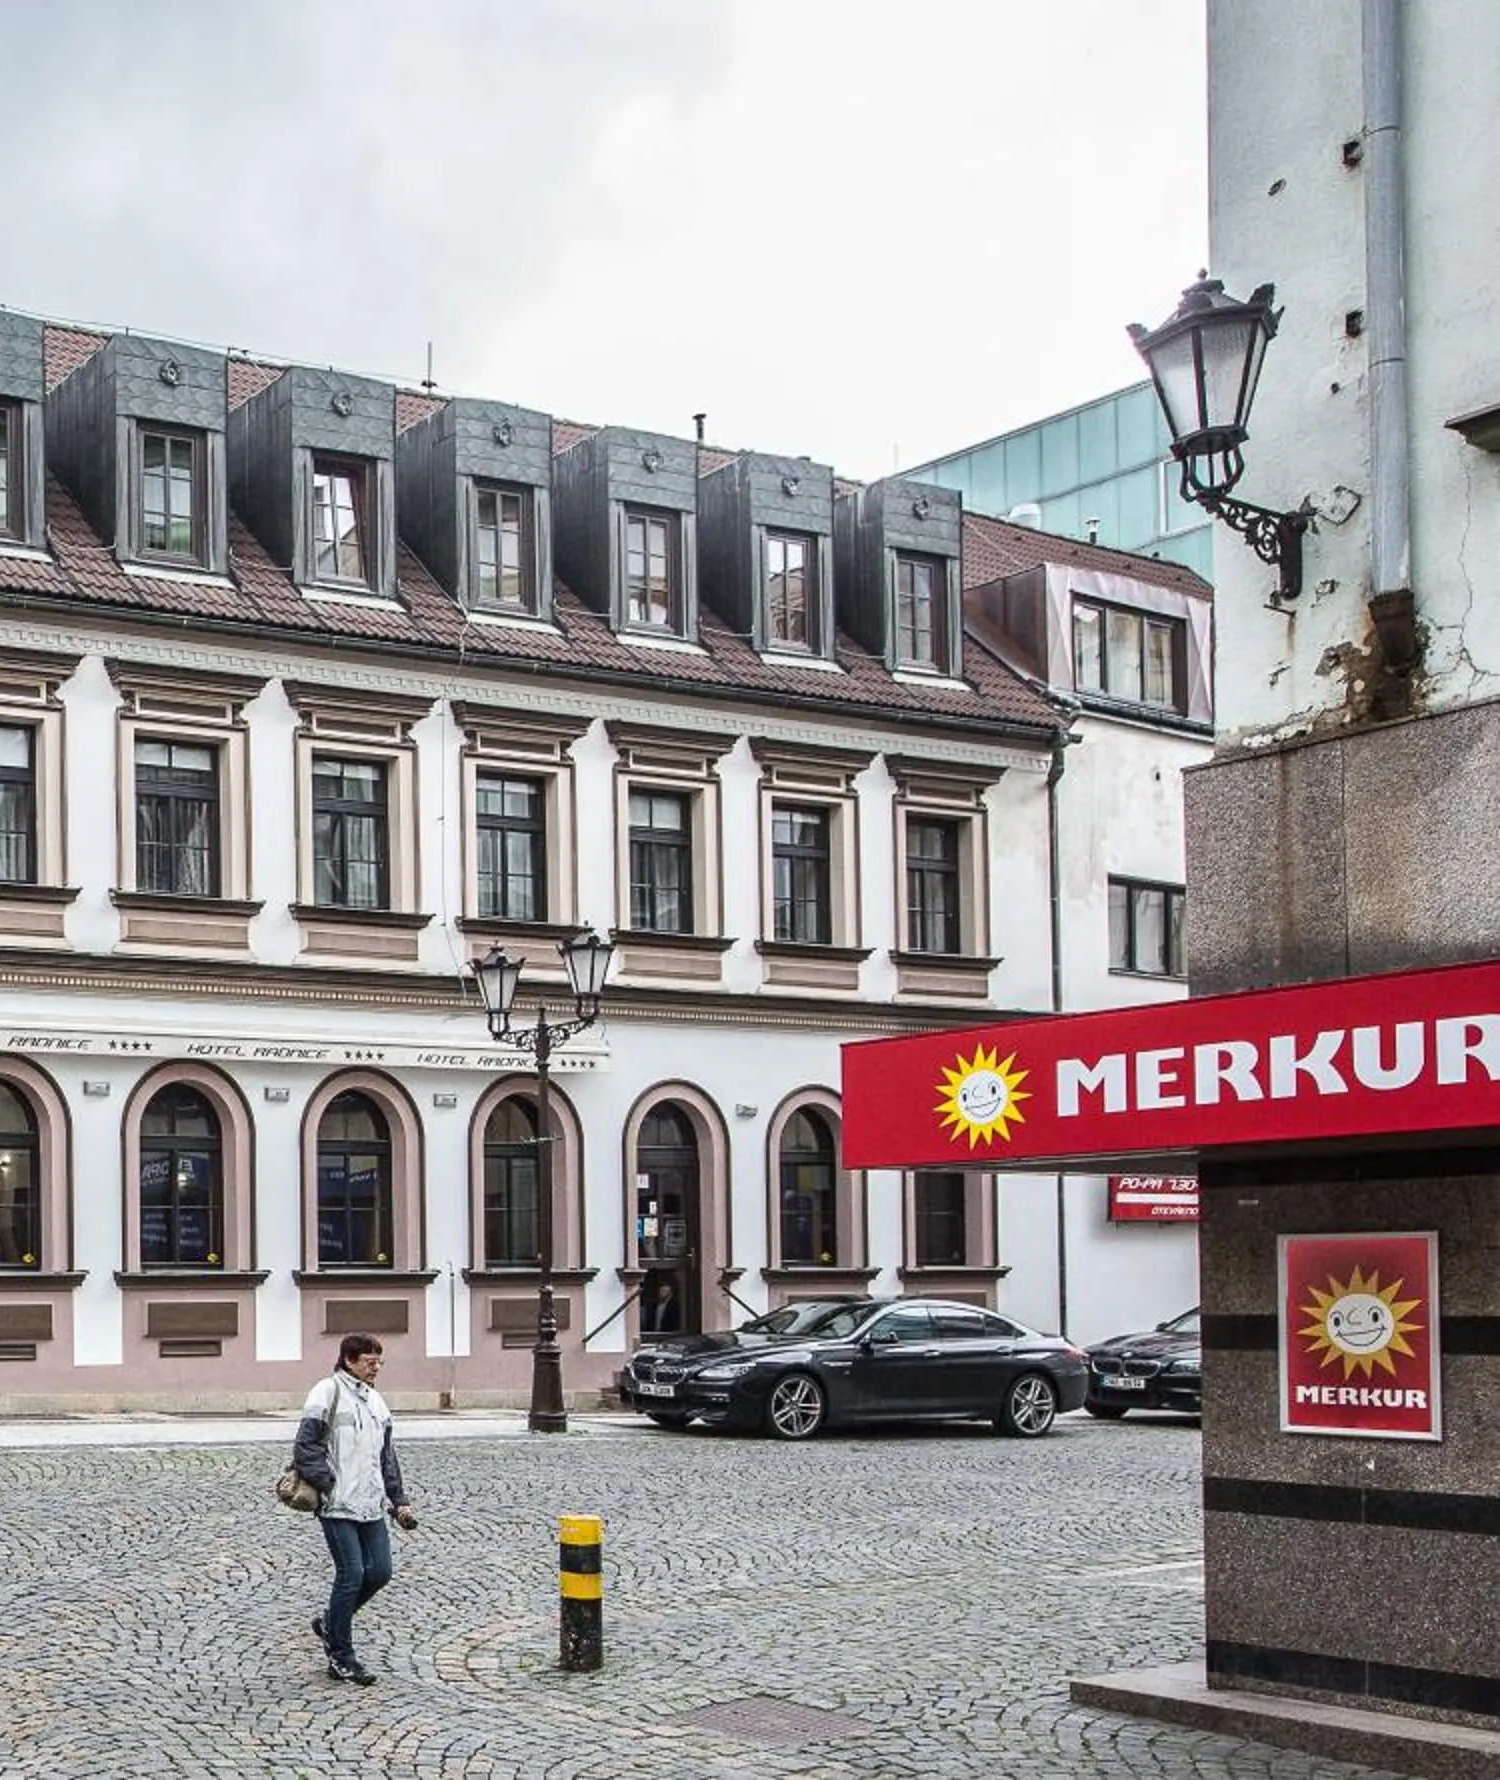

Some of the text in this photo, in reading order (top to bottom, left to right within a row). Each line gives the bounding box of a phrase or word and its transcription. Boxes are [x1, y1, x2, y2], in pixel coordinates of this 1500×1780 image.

[8, 1036, 93, 1051] RADNICE
[187, 1043, 331, 1060] HOTEL RADNICE
[417, 1052, 536, 1068] HOTEL RADNIC
[1056, 1014, 1500, 1118] MERKUR
[1296, 1385, 1428, 1409] MERKUR
